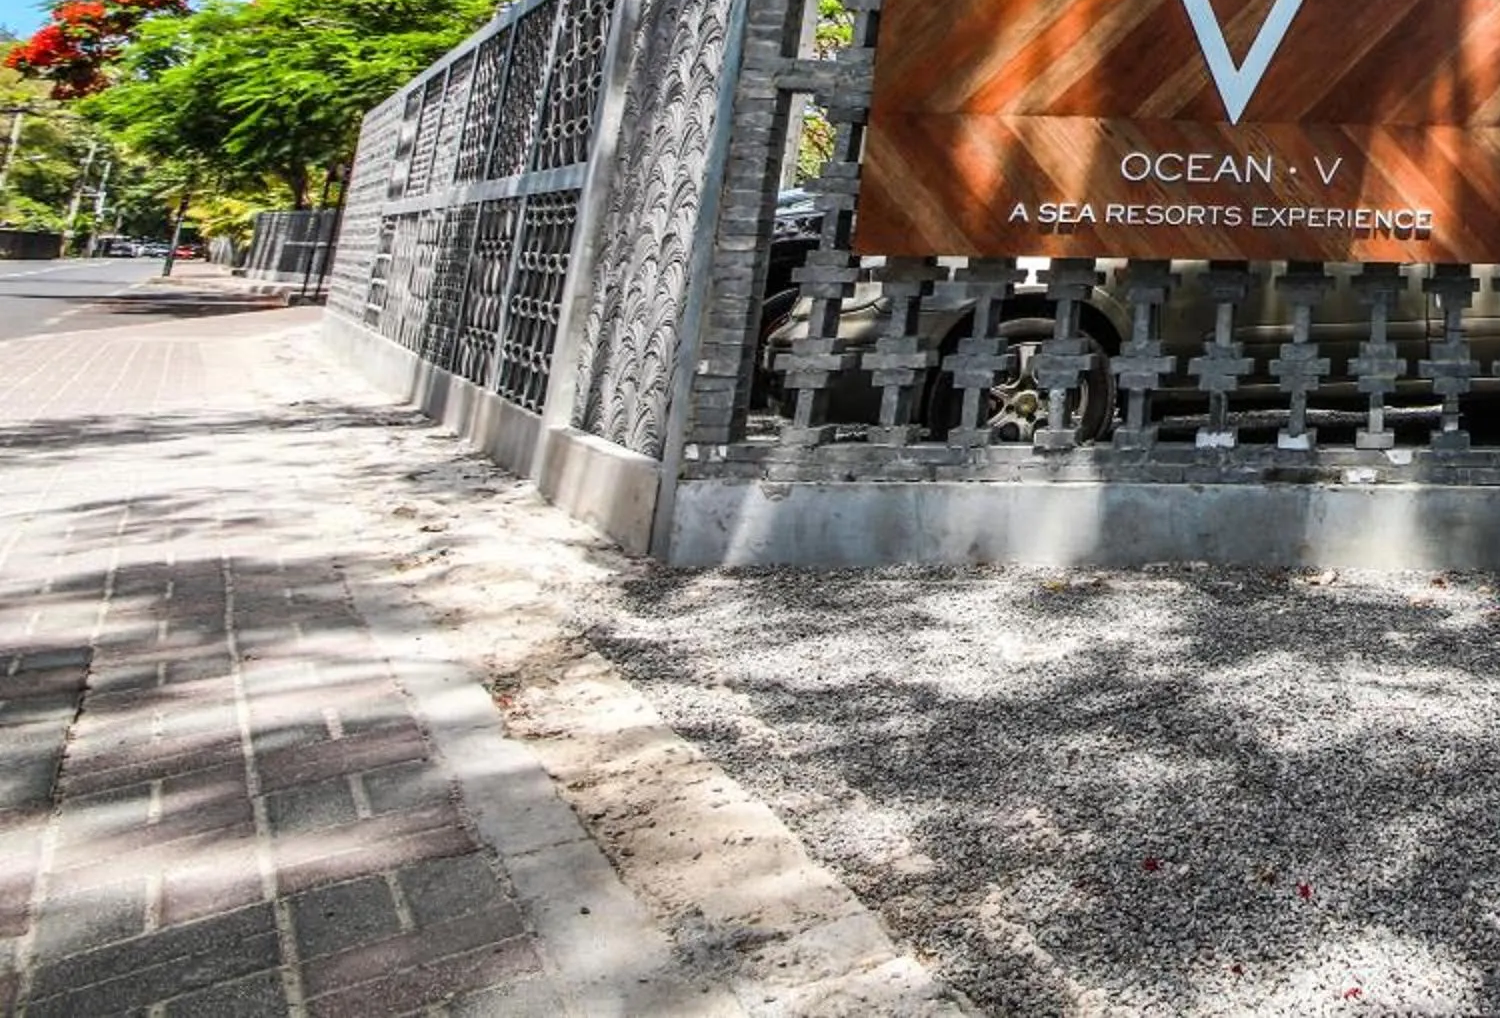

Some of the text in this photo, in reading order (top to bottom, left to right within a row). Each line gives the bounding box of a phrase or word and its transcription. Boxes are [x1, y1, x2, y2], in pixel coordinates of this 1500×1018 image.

[1120, 151, 1272, 183] OCEAN
[1313, 156, 1343, 185] V
[1008, 202, 1433, 230] A SEA RESORTS EXPERIENCE
